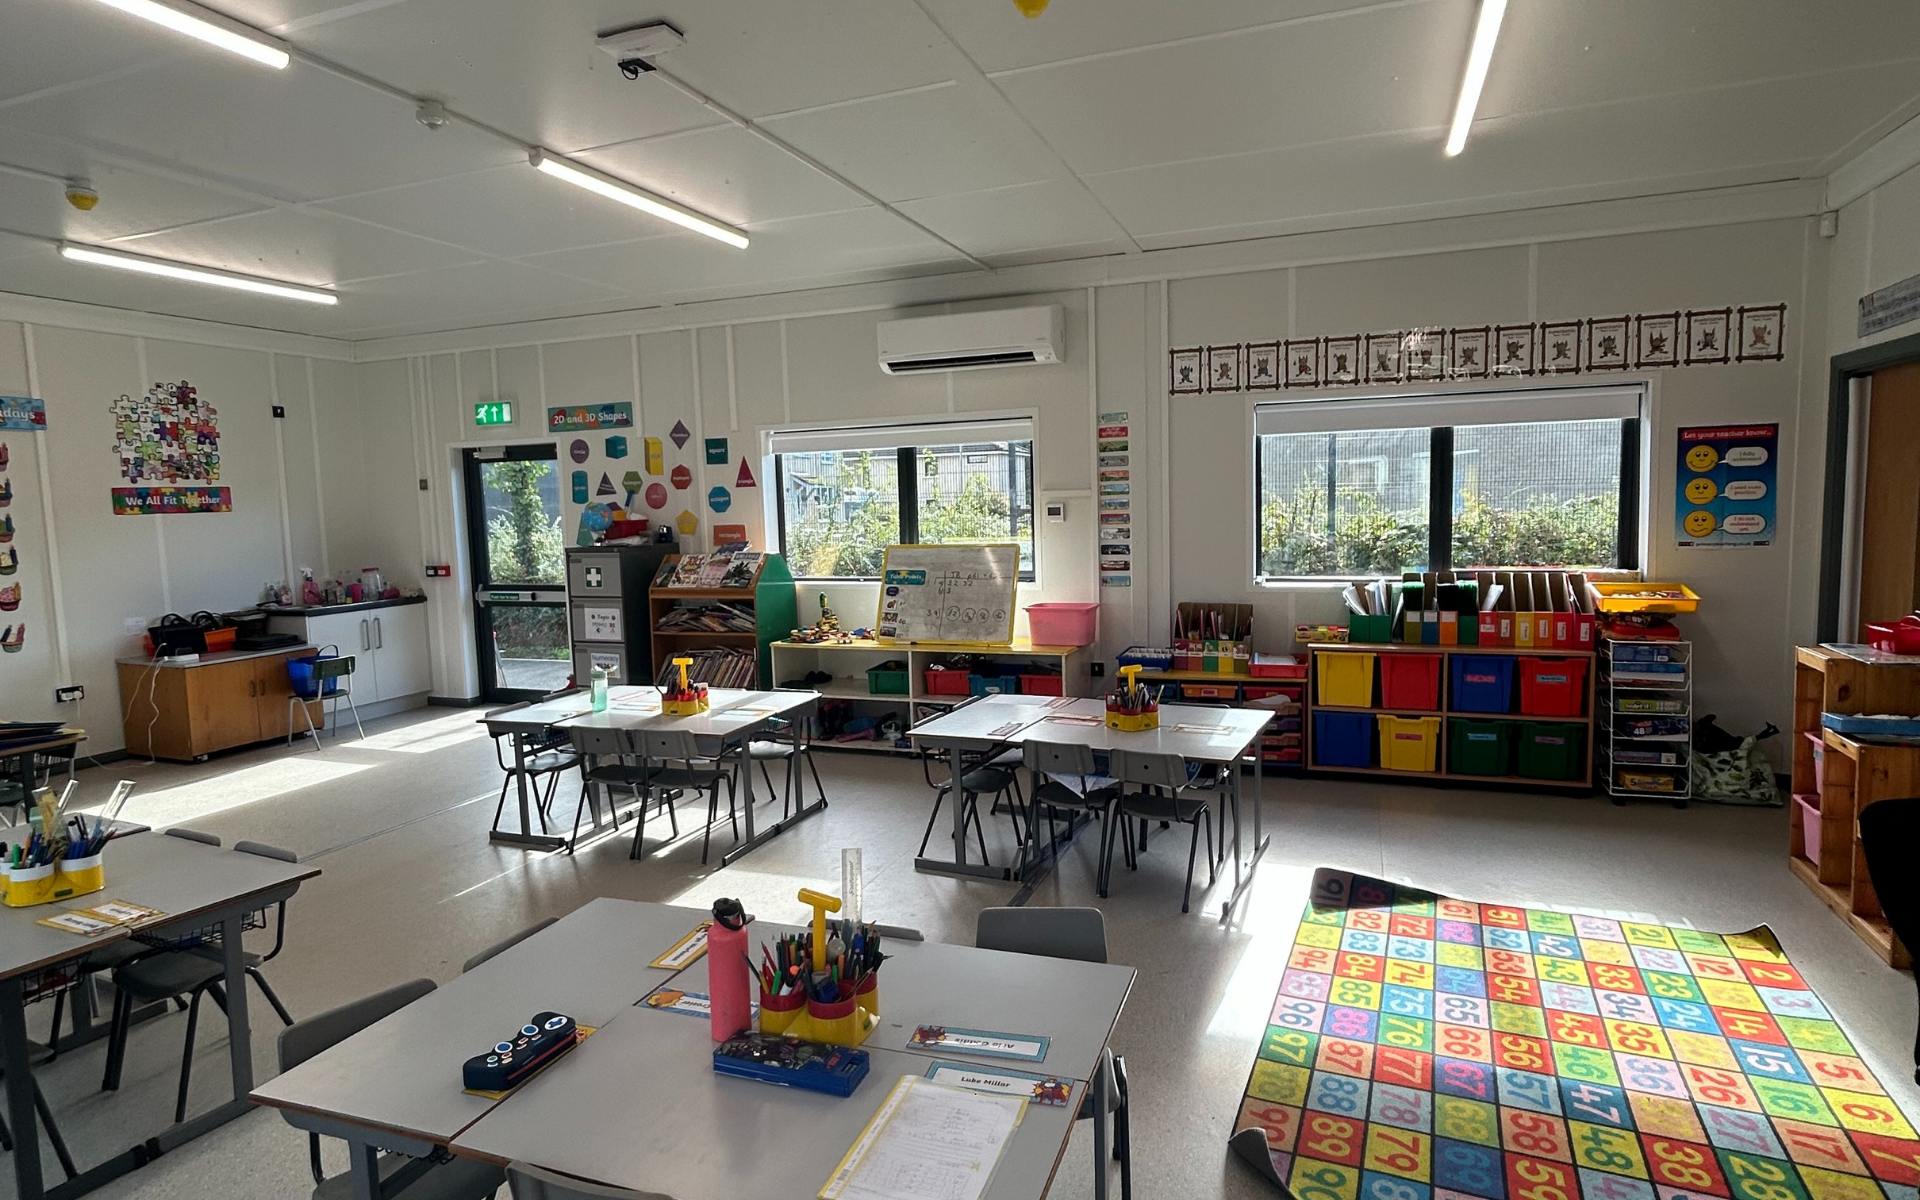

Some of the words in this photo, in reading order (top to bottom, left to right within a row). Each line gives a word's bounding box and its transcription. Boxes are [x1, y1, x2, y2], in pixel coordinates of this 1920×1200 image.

[554, 415, 564, 424] 2D
[567, 414, 582, 423] and
[585, 413, 595, 422] 3D
[598, 412, 627, 422] Shapes
[1698, 431, 1715, 439] your
[125, 496, 143, 506] We
[146, 495, 161, 505] All
[164, 495, 177, 505] Fit
[181, 494, 221, 507] Together
[592, 654, 619, 662] Numeracy
[1633, 727, 1645, 735] 48
[1630, 777, 1637, 786] 5
[1316, 878, 1345, 900] 91
[1308, 911, 1338, 925] 2
[1353, 911, 1383, 930] 82
[1443, 904, 1473, 919] 61
[1487, 910, 1520, 926] 51
[1535, 914, 1567, 933] 41
[1396, 916, 1427, 937] 72
[1442, 921, 1474, 943] 62
[1581, 920, 1616, 938] 31
[1628, 927, 1667, 944] 21
[1347, 932, 1380, 952] 83
[1395, 939, 1427, 959] 73
[1489, 929, 1523, 949] 52
[1537, 936, 1574, 957] 42
[1680, 935, 1719, 949] 11
[1294, 950, 1329, 969] 94
[1342, 954, 1377, 977] 84
[1491, 951, 1527, 974] 53
[1542, 959, 1580, 982] 43
[1638, 948, 1679, 971] 22
[1691, 957, 1735, 977] 12
[1392, 962, 1426, 983] 74
[1442, 968, 1477, 992] 64
[1594, 966, 1634, 990] 33
[1750, 966, 1793, 981] 2
[1287, 974, 1322, 997] 95
[1338, 980, 1373, 1006] 85
[1494, 975, 1532, 1001] 54
[1547, 984, 1589, 1010] 44
[1649, 972, 1694, 999] 23
[680, 1000, 711, 1010] Crozier
[1389, 988, 1425, 1015] 75
[1444, 997, 1481, 1024] 65
[1604, 993, 1646, 1019] 34
[1771, 995, 1813, 1009] 3
[1279, 1001, 1316, 1027] 96
[1331, 1008, 1370, 1038] 86
[1662, 1001, 1705, 1028] 24
[1721, 1011, 1769, 1036] 14
[1385, 1018, 1425, 1048] 76
[1554, 1013, 1599, 1045] 45
[1614, 1023, 1661, 1055] 35
[1794, 1026, 1834, 1044] 4
[1269, 1032, 1309, 1063] 97
[1443, 1027, 1483, 1057] 66
[1500, 1035, 1544, 1069] 56
[1325, 1040, 1365, 1074] 87
[1383, 1052, 1423, 1084] 77
[1562, 1046, 1608, 1080] 46
[1740, 1046, 1796, 1075] 15
[961, 1076, 981, 1084] Luke
[984, 1078, 1011, 1088] Millar
[1443, 1062, 1487, 1098] 67
[1625, 1058, 1676, 1093] 36
[1815, 1061, 1865, 1081] 5
[1317, 1076, 1360, 1112] 88
[1505, 1071, 1551, 1110] 57
[1689, 1067, 1746, 1105] 26
[1379, 1089, 1422, 1125] 78
[1570, 1084, 1622, 1124] 47
[1761, 1085, 1819, 1115] 16
[1444, 1101, 1489, 1140] 68
[1841, 1103, 1895, 1124] 6
[1308, 1117, 1354, 1158] 89
[1510, 1112, 1559, 1155] 58
[1708, 1109, 1773, 1153] 27
[1374, 1131, 1421, 1173] 79
[1581, 1126, 1633, 1170] 48
[1785, 1128, 1850, 1163] 17
[1444, 1147, 1492, 1190] 69
[1653, 1141, 1713, 1188] 38
[1371, 1179, 1419, 1200] 8
[1592, 1176, 1641, 1199] 4
[1729, 1155, 1797, 1200] 28
